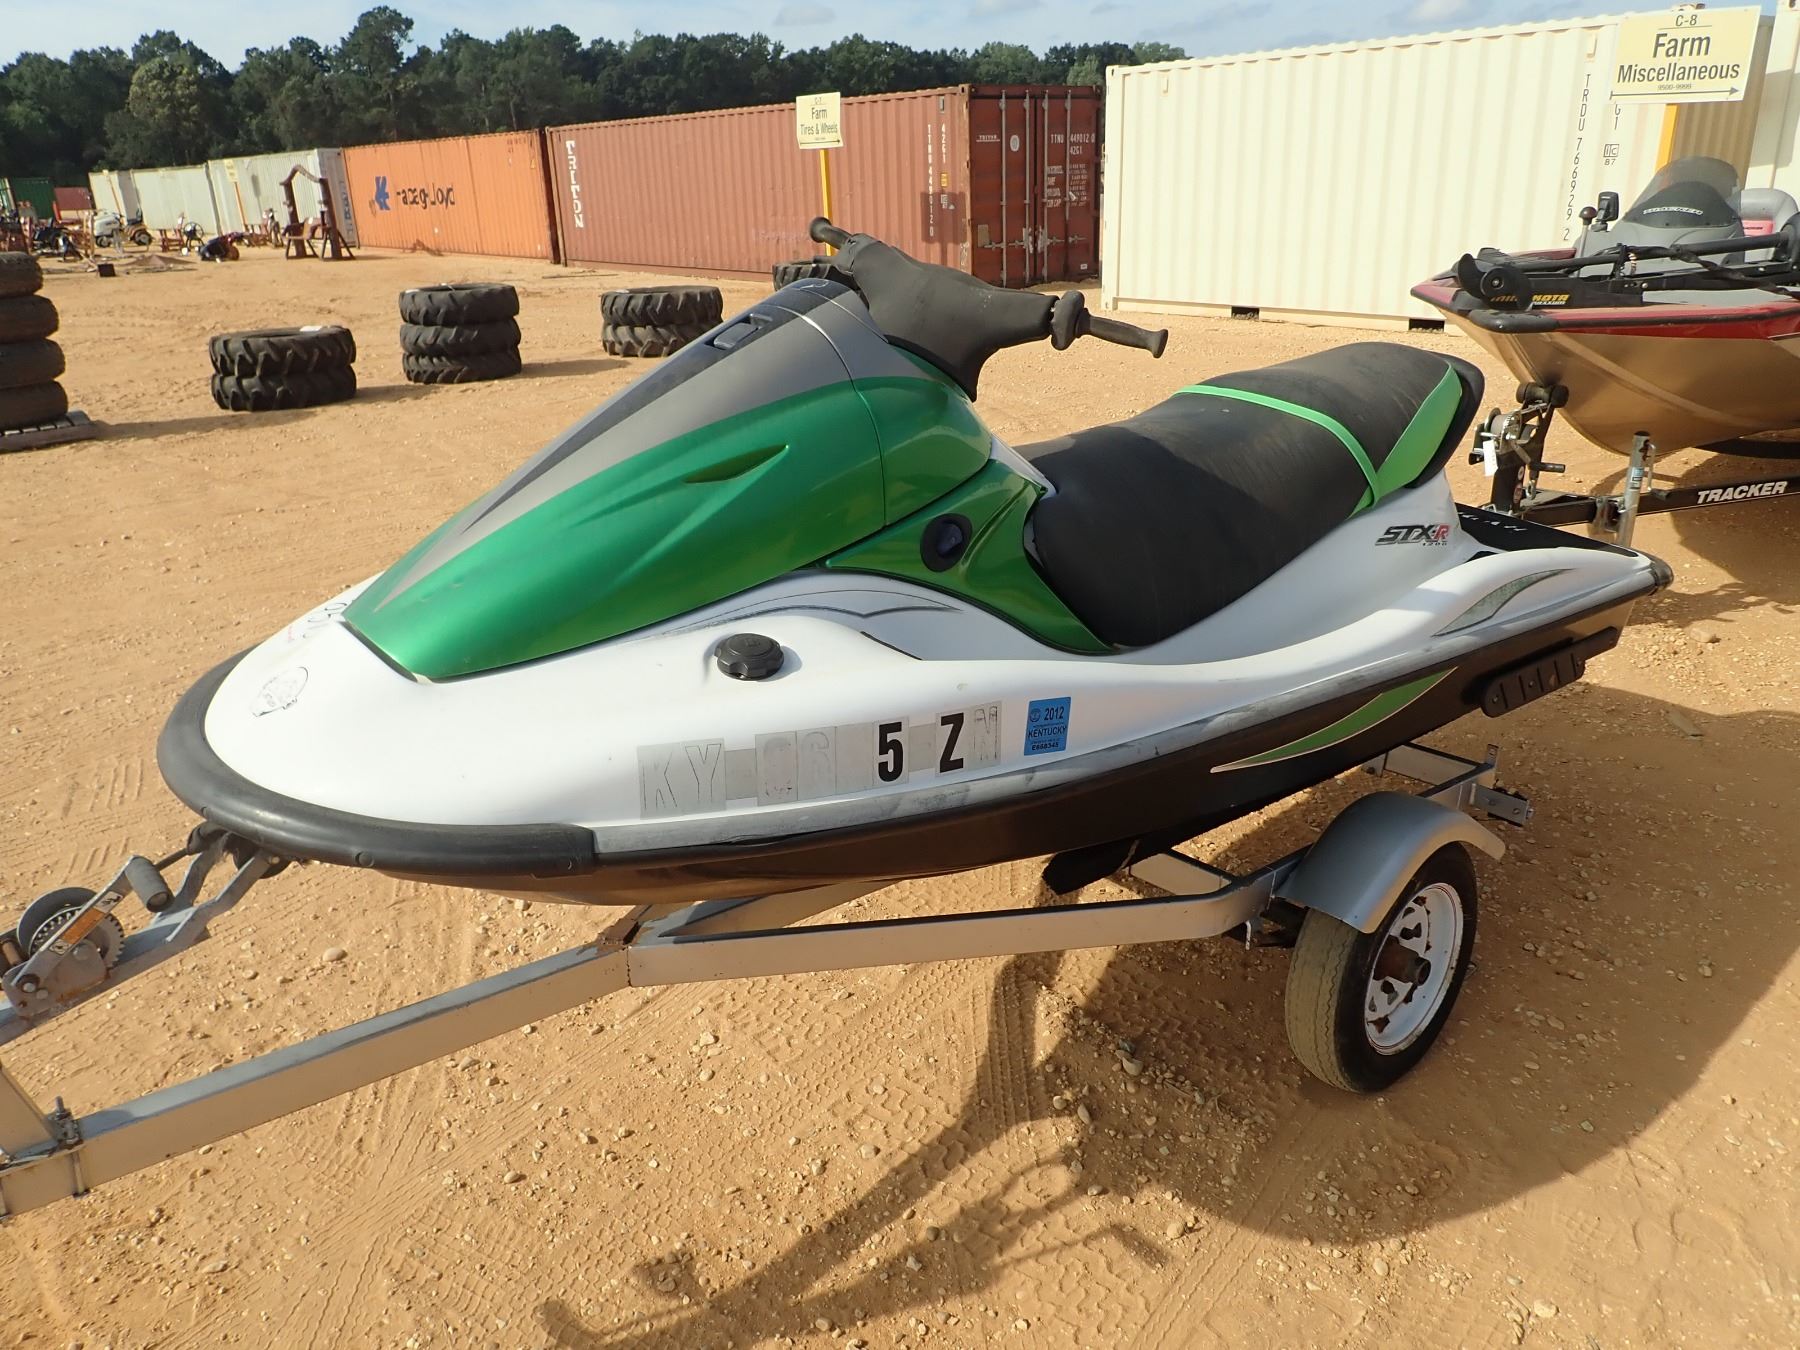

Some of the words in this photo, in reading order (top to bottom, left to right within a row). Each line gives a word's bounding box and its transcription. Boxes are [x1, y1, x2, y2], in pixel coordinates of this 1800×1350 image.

[1675, 14, 1698, 27] C-8
[1653, 33, 1711, 58] Farm
[1617, 62, 1740, 83] Miscellaneous
[1578, 74, 1591, 131] TRDU
[811, 107, 828, 120] Farm
[800, 124, 814, 135] Tires
[1566, 137, 1582, 221] 766929
[1697, 481, 1788, 504] TRACKER
[1044, 706, 1065, 721] 2012
[1028, 725, 1067, 738] KENTUCKY
